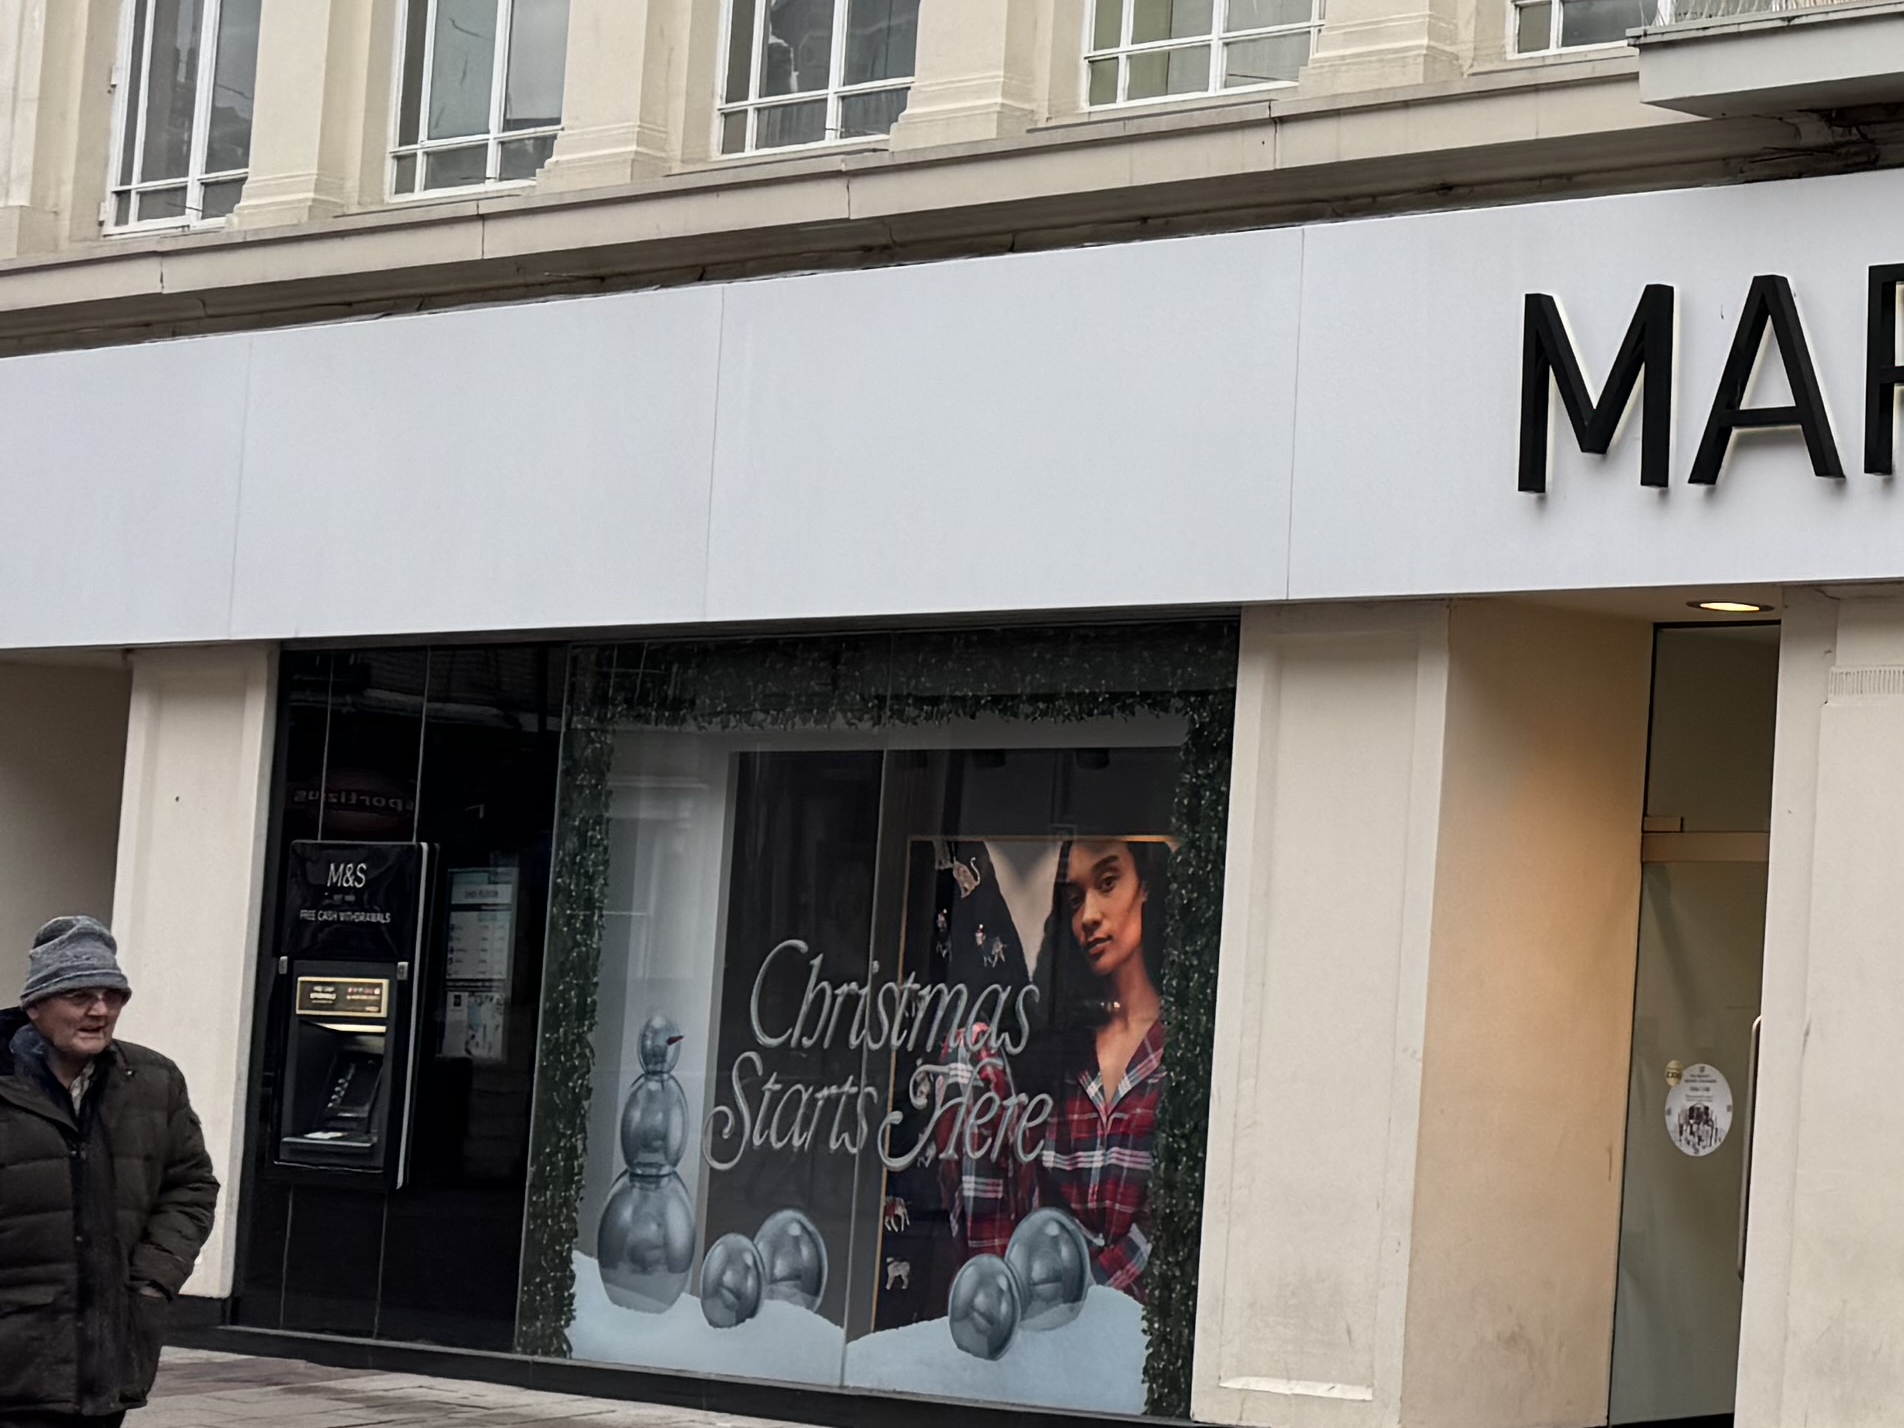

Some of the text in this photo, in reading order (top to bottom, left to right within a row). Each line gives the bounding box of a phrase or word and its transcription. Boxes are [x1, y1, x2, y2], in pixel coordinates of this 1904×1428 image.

[327, 863, 367, 888] M&S
[300, 909, 391, 923] FREE CASH WITHDRAWALS
[750, 939, 1040, 1056] Christmas
[702, 1052, 1054, 1171] Starts Here
